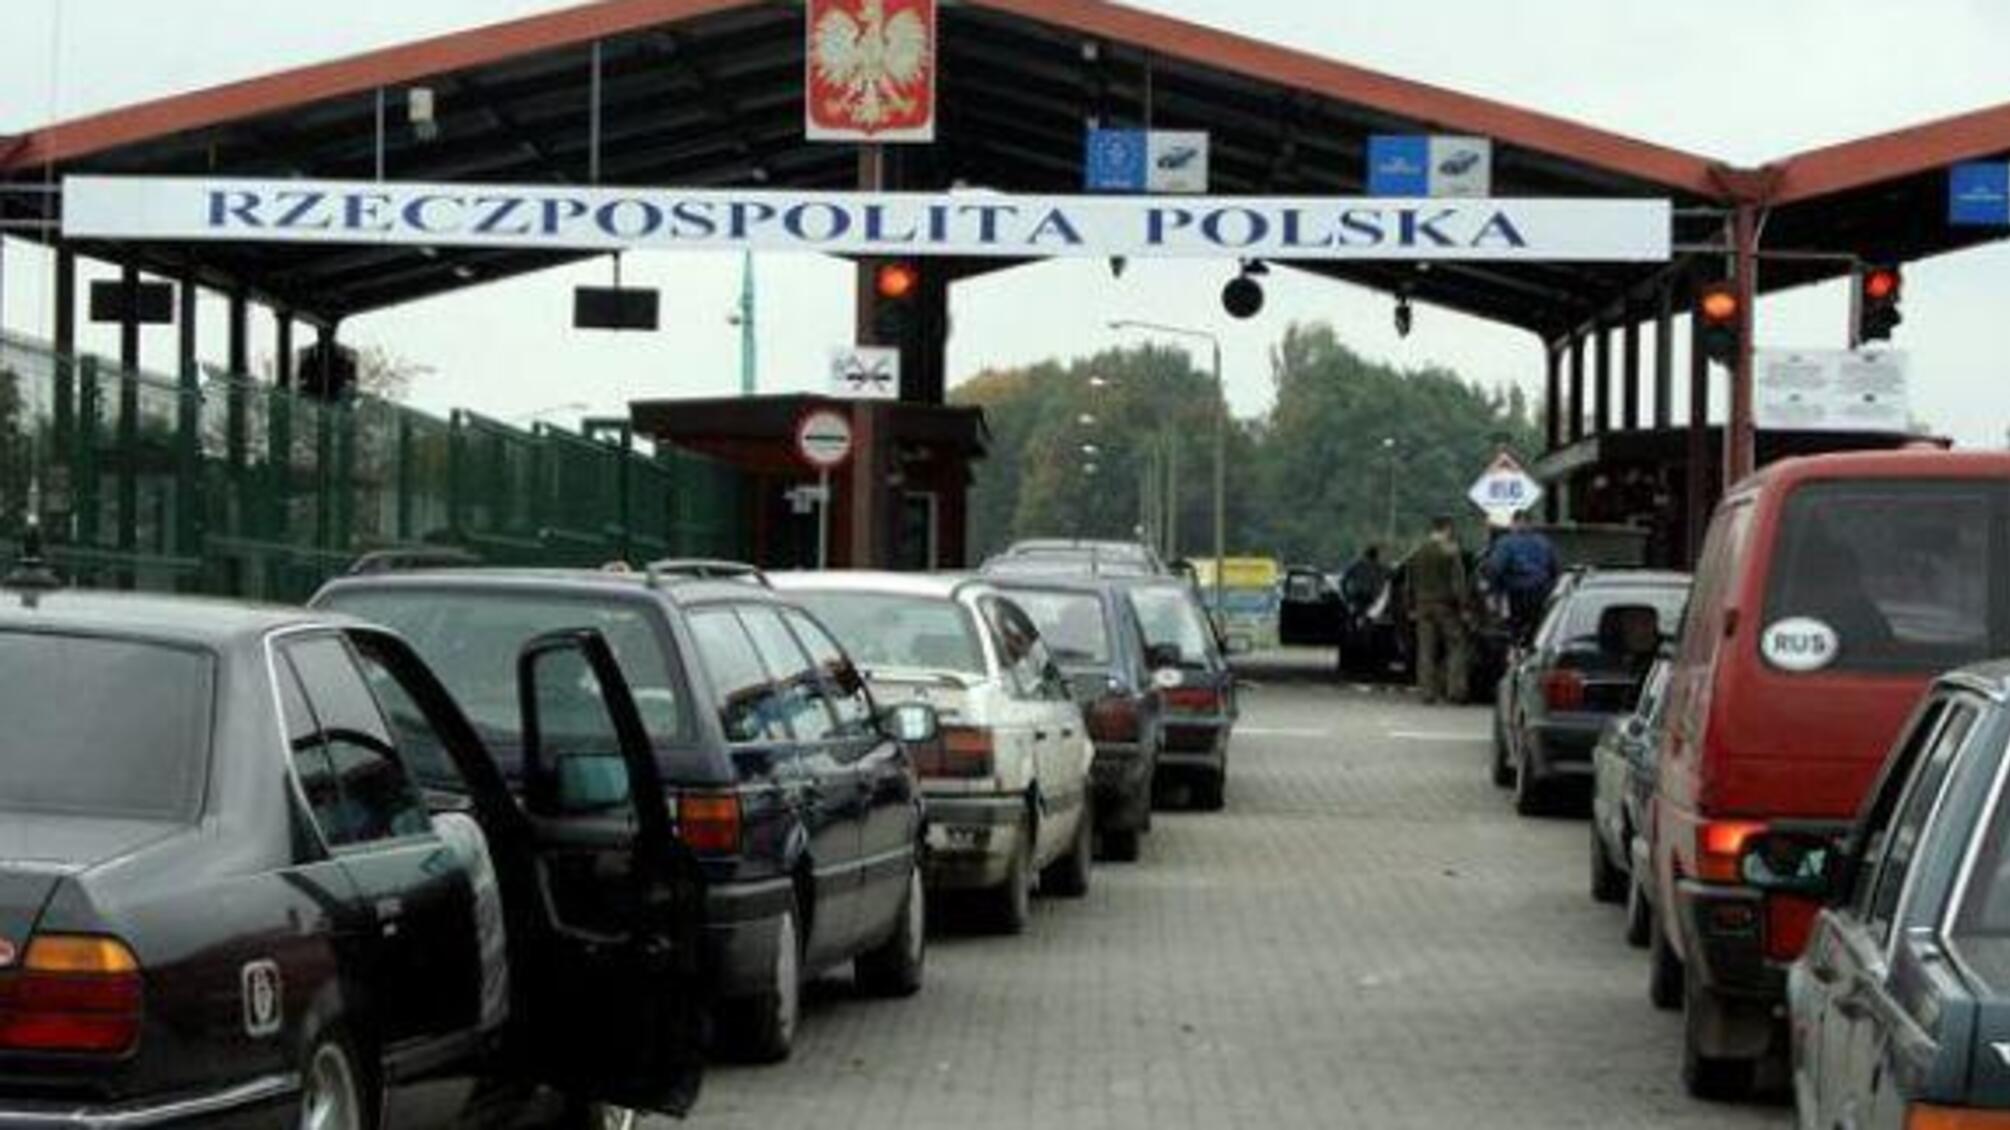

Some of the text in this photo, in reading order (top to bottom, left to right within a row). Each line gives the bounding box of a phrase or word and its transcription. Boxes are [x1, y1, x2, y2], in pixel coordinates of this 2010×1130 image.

[207, 190, 1528, 248] RZECZPOSPOLITA POLSKA
[1774, 632, 1826, 656] RUS
